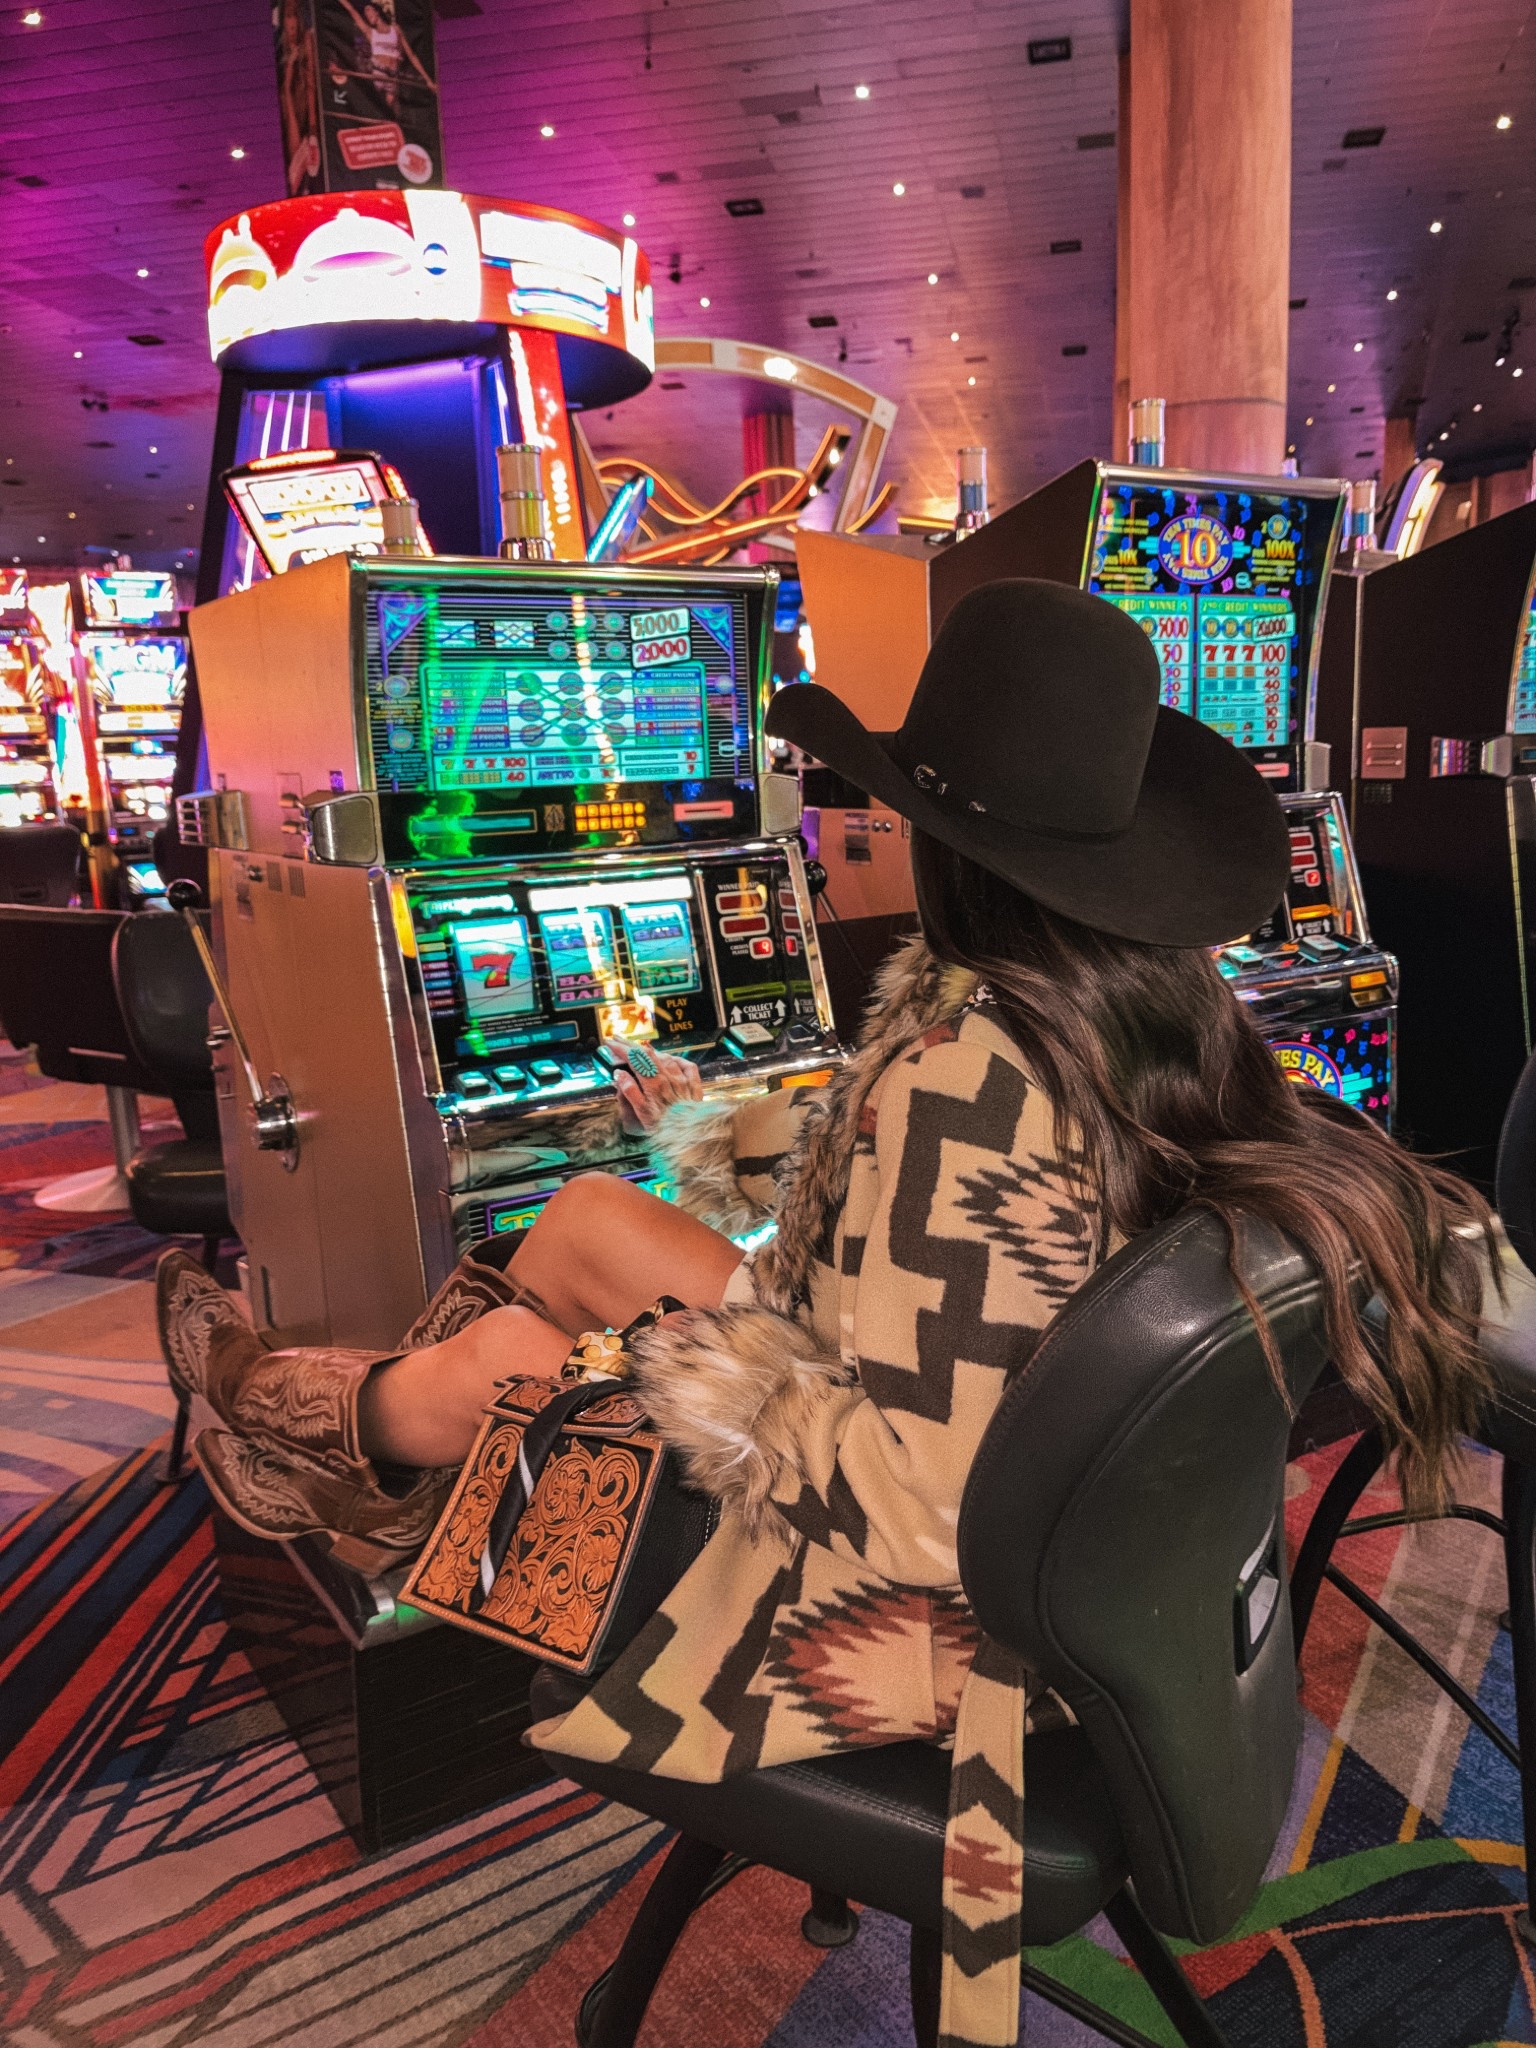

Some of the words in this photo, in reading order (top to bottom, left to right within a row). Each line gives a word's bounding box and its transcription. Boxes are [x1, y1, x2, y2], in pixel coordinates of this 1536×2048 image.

[1175, 530, 1217, 569] 10
[1265, 539, 1295, 559] 100X
[1149, 600, 1187, 611] WINNES
[1163, 644, 1182, 663] 50
[1204, 645, 1218, 662] 7
[1223, 645, 1237, 662] 7
[1242, 645, 1256, 662] 7
[1261, 644, 1286, 662] 100
[1264, 666, 1280, 677] 60
[1264, 680, 1280, 690] 40
[1264, 693, 1280, 704] 20
[1267, 732, 1275, 743] 4
[471, 952, 517, 989] 7
[666, 997, 687, 1008] PLAY
[743, 1002, 773, 1014] COLLECT
[675, 1008, 683, 1020] 9
[748, 1010, 771, 1020] TICKET
[669, 1020, 694, 1032] LINES
[1302, 1052, 1336, 1087] PAY
